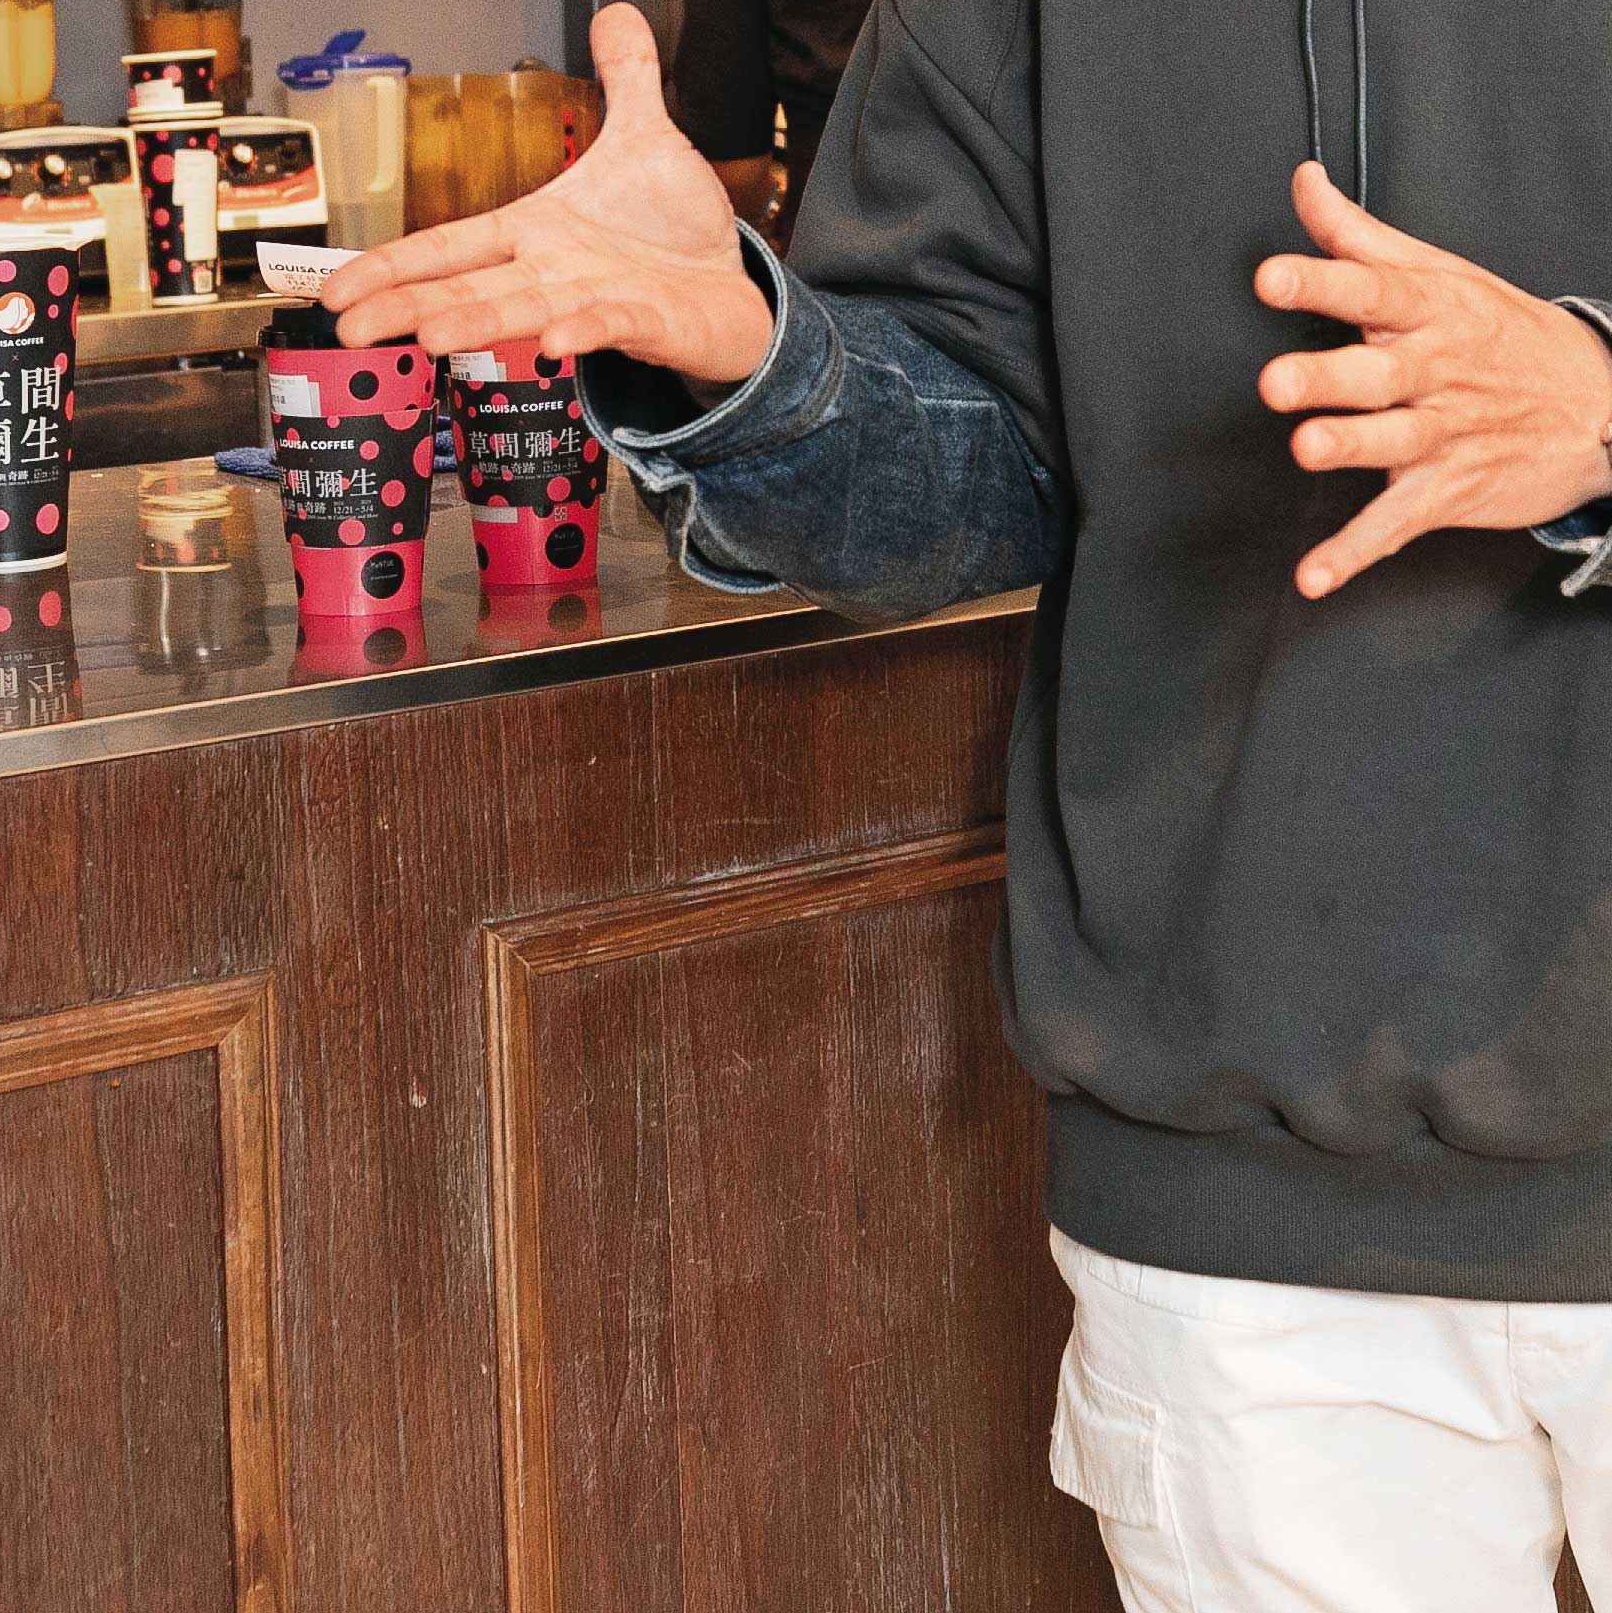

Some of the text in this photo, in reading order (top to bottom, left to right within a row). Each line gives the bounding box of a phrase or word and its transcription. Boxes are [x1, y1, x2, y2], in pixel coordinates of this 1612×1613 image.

[268, 263, 317, 274] LOUISA
[14, 337, 44, 347] COFFEE
[480, 400, 564, 414] LOUISA COFFEE
[279, 438, 355, 450] LOUISA COFFEE
[468, 426, 582, 460] 草間彌生
[333, 505, 354, 516] 12/21
